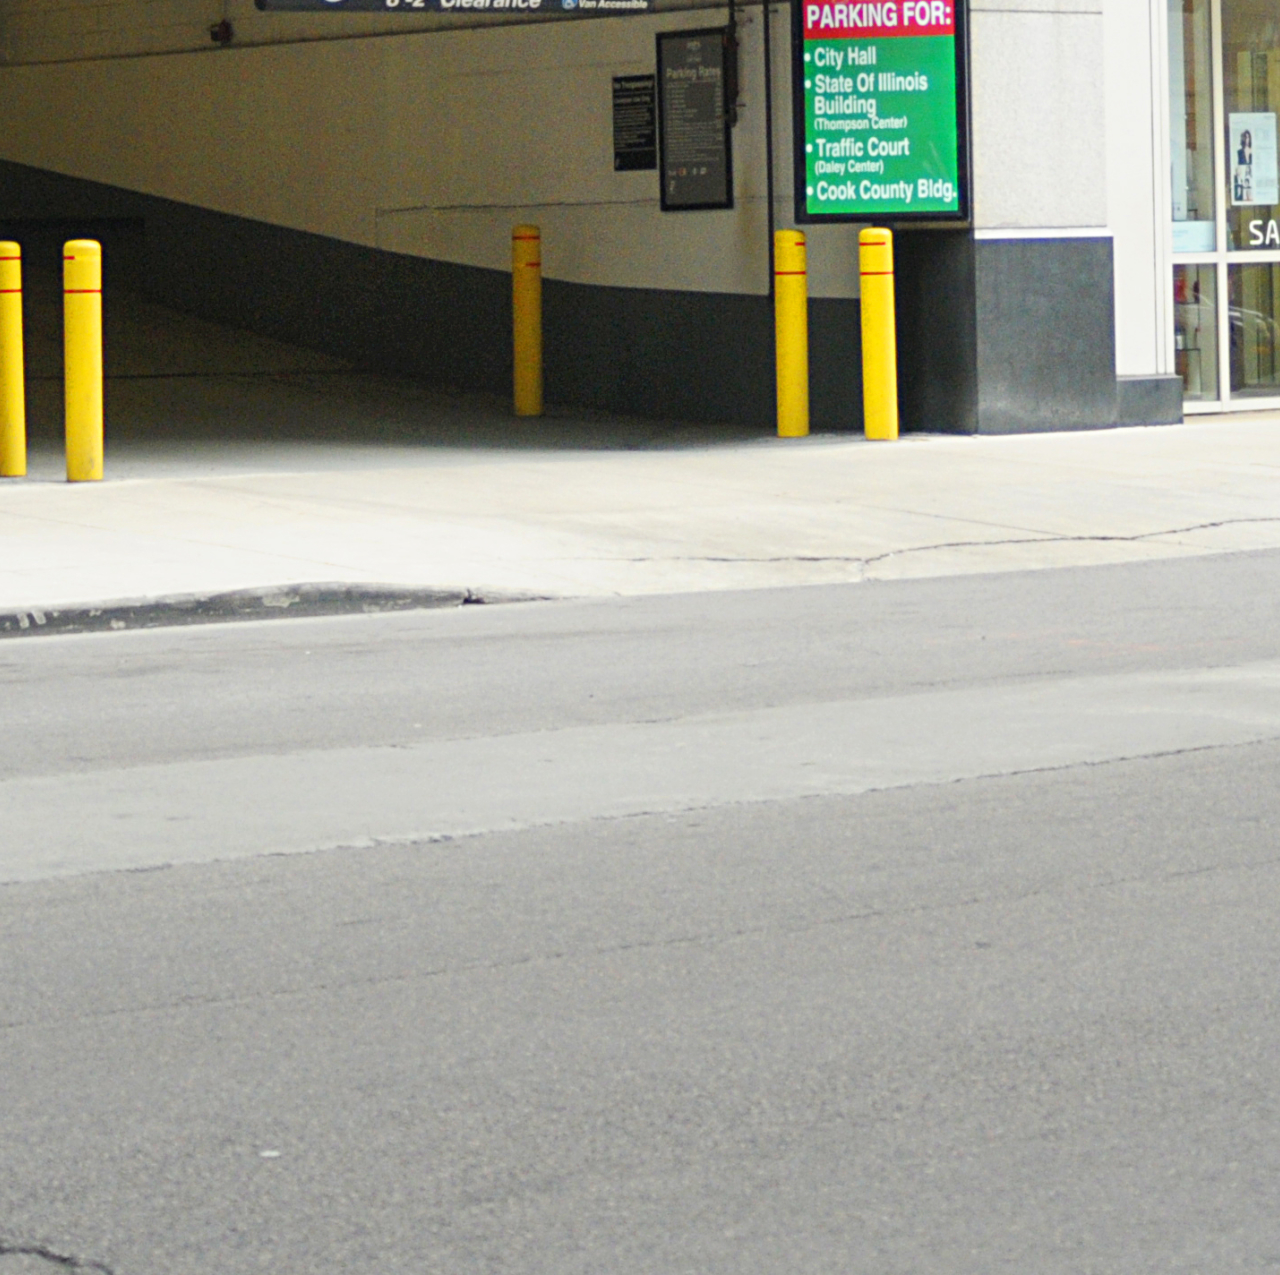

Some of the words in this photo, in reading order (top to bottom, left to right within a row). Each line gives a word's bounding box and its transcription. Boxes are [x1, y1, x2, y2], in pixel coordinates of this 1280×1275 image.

[806, 1, 898, 29] PARKING
[902, 0, 952, 27] FOR:
[813, 46, 844, 71] City
[847, 46, 877, 66] Hall
[814, 74, 853, 94] State
[856, 72, 875, 93] Of
[877, 71, 929, 92] Illinois
[813, 95, 877, 119] Building
[813, 117, 870, 133] (Thompson
[871, 115, 908, 130] Center)
[816, 137, 864, 157] Traffic
[867, 137, 910, 156] Court
[814, 159, 846, 176] (Daley
[847, 158, 884, 174] Center)
[816, 180, 857, 200] Cook
[859, 179, 913, 203] County
[917, 178, 957, 202] Bldg.
